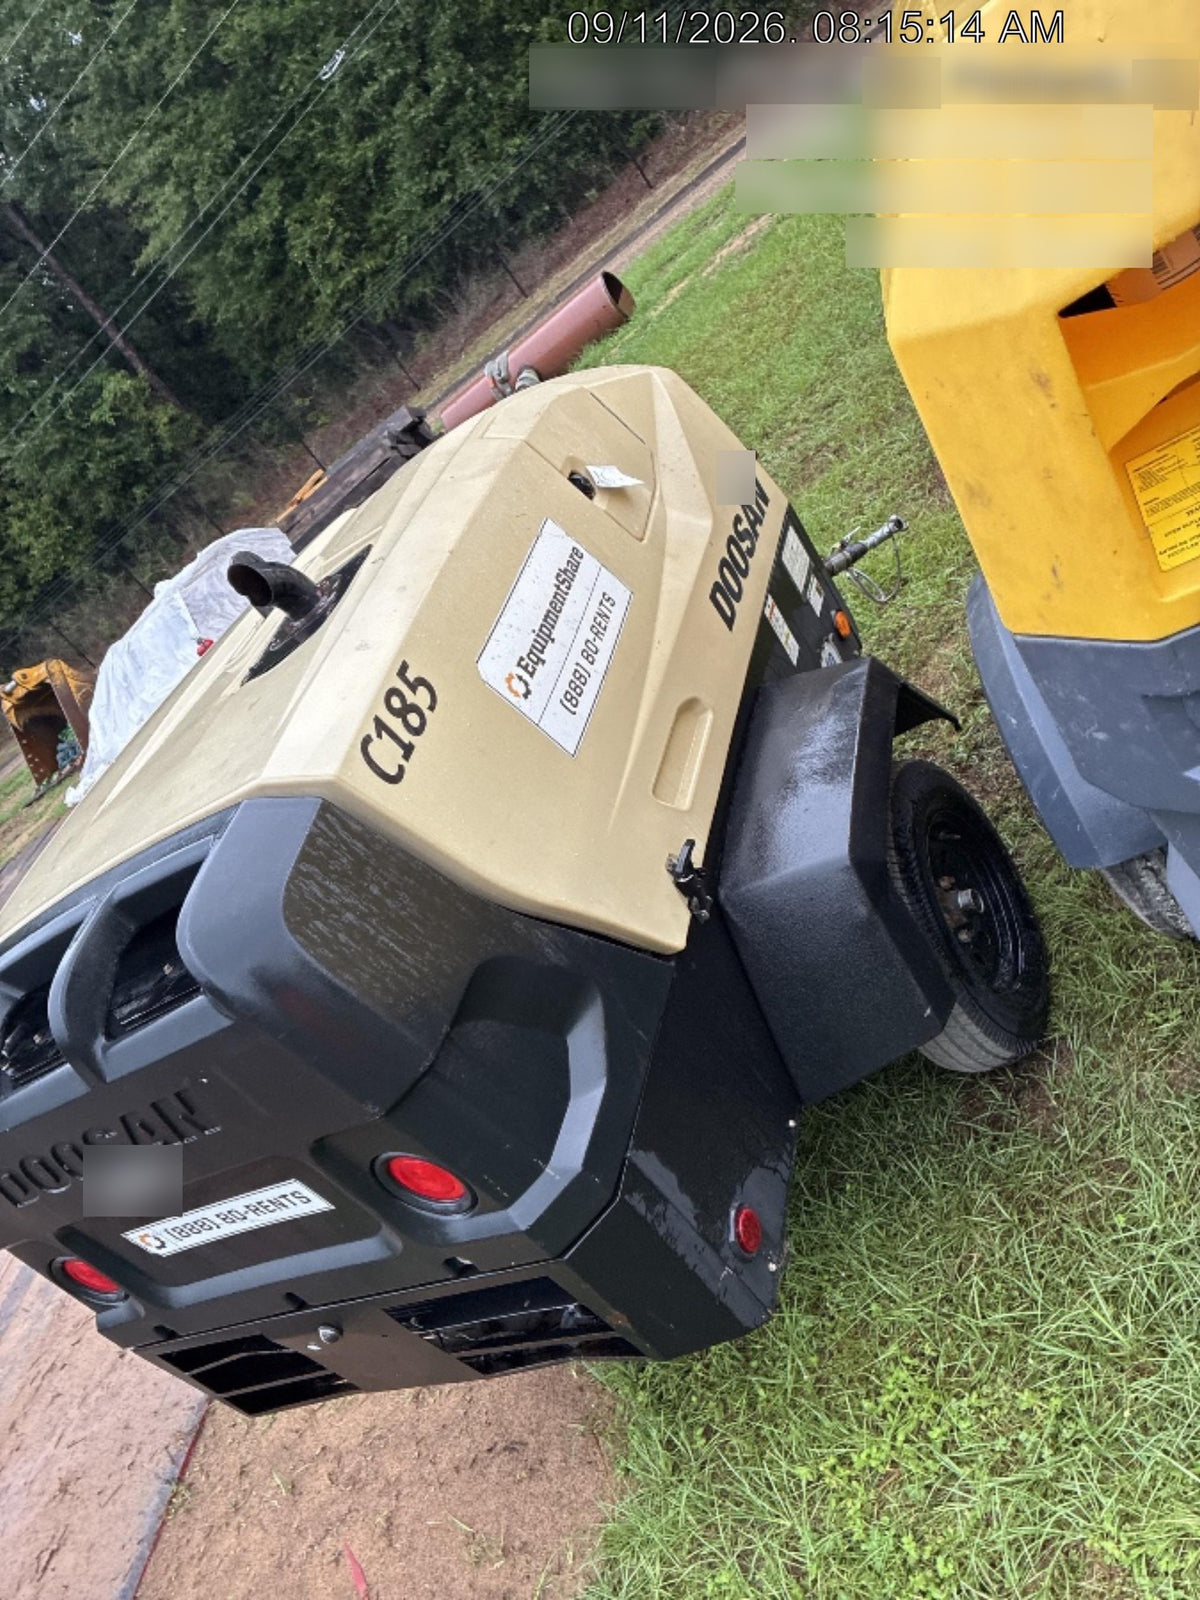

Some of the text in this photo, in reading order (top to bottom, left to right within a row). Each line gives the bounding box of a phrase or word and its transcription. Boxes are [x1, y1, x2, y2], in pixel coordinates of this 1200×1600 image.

[516, 546, 584, 679] EquipmentShare
[360, 659, 438, 785] C185
[559, 662, 591, 716] (888)
[166, 1216, 218, 1242] (888)
